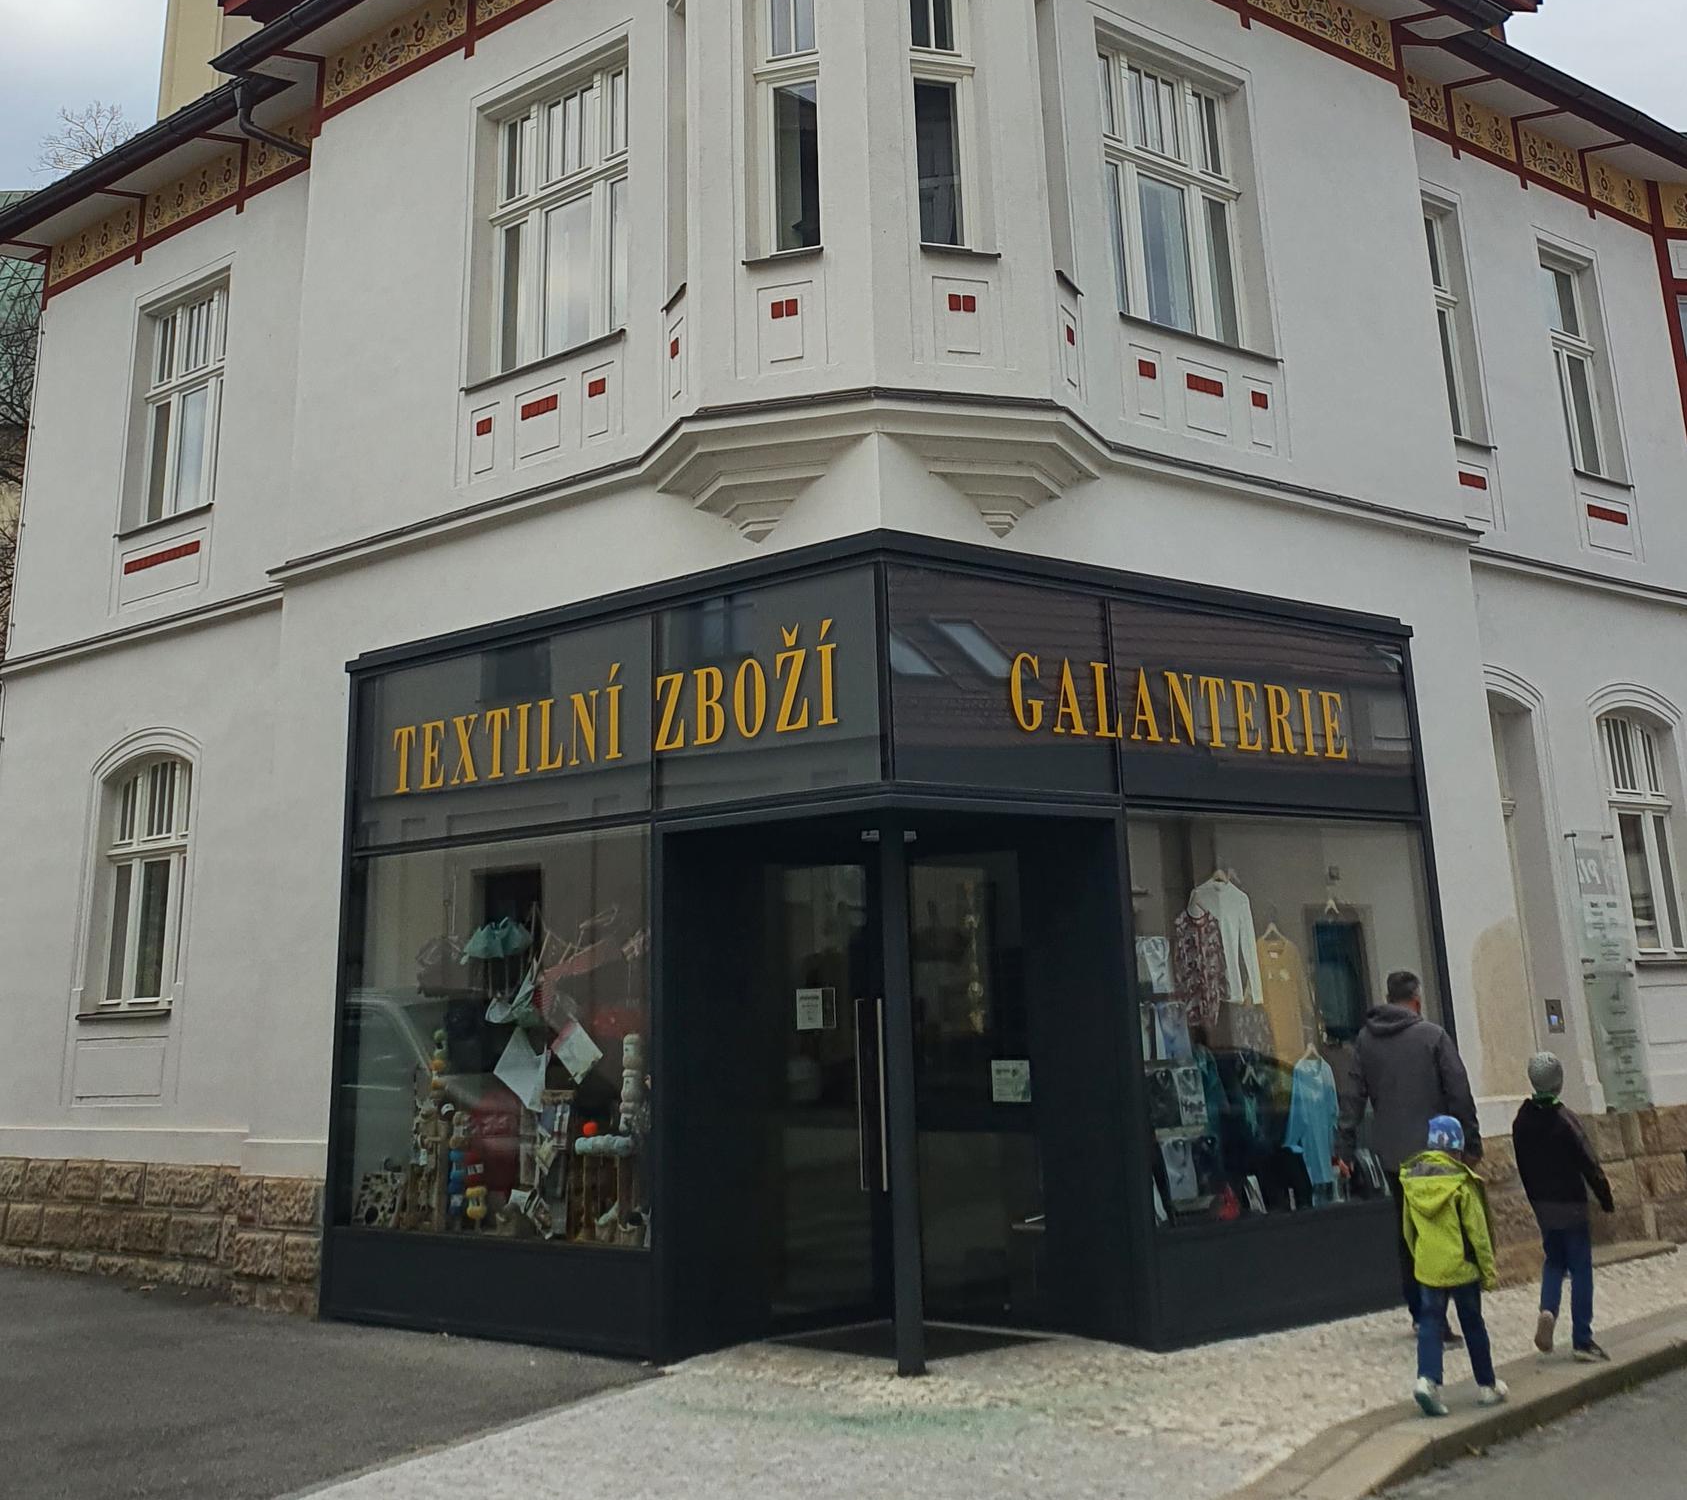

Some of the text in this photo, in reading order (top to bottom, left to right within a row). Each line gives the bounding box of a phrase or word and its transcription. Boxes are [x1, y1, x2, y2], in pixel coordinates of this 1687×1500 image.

[393, 617, 840, 794] TEXTILNÍ ZBOŽÍ
[1010, 651, 1348, 760] GALANTERIE
